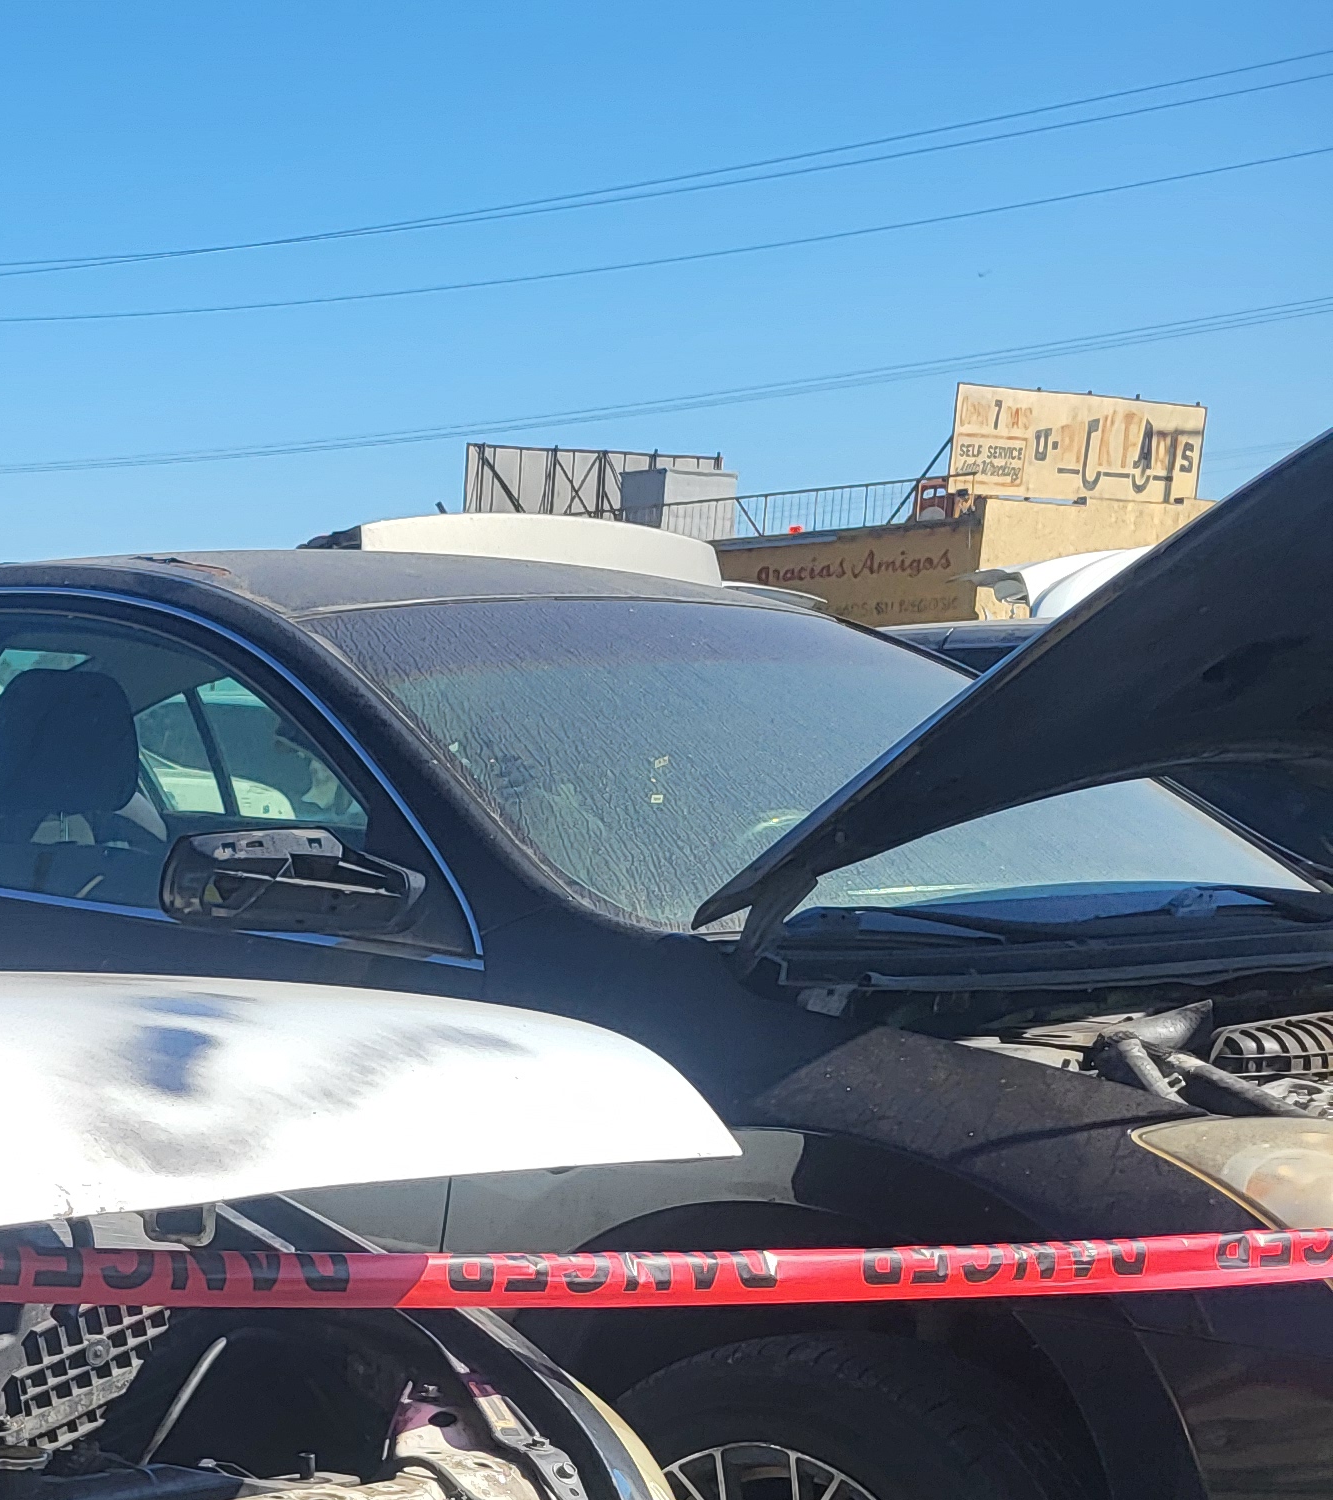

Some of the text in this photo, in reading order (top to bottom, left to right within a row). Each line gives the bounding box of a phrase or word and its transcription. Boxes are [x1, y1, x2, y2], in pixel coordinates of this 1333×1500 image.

[993, 398, 1003, 430] 7
[958, 443, 1023, 461] SELF SERVICE
[980, 459, 1022, 483] Wrecking
[851, 549, 952, 579] Amigos
